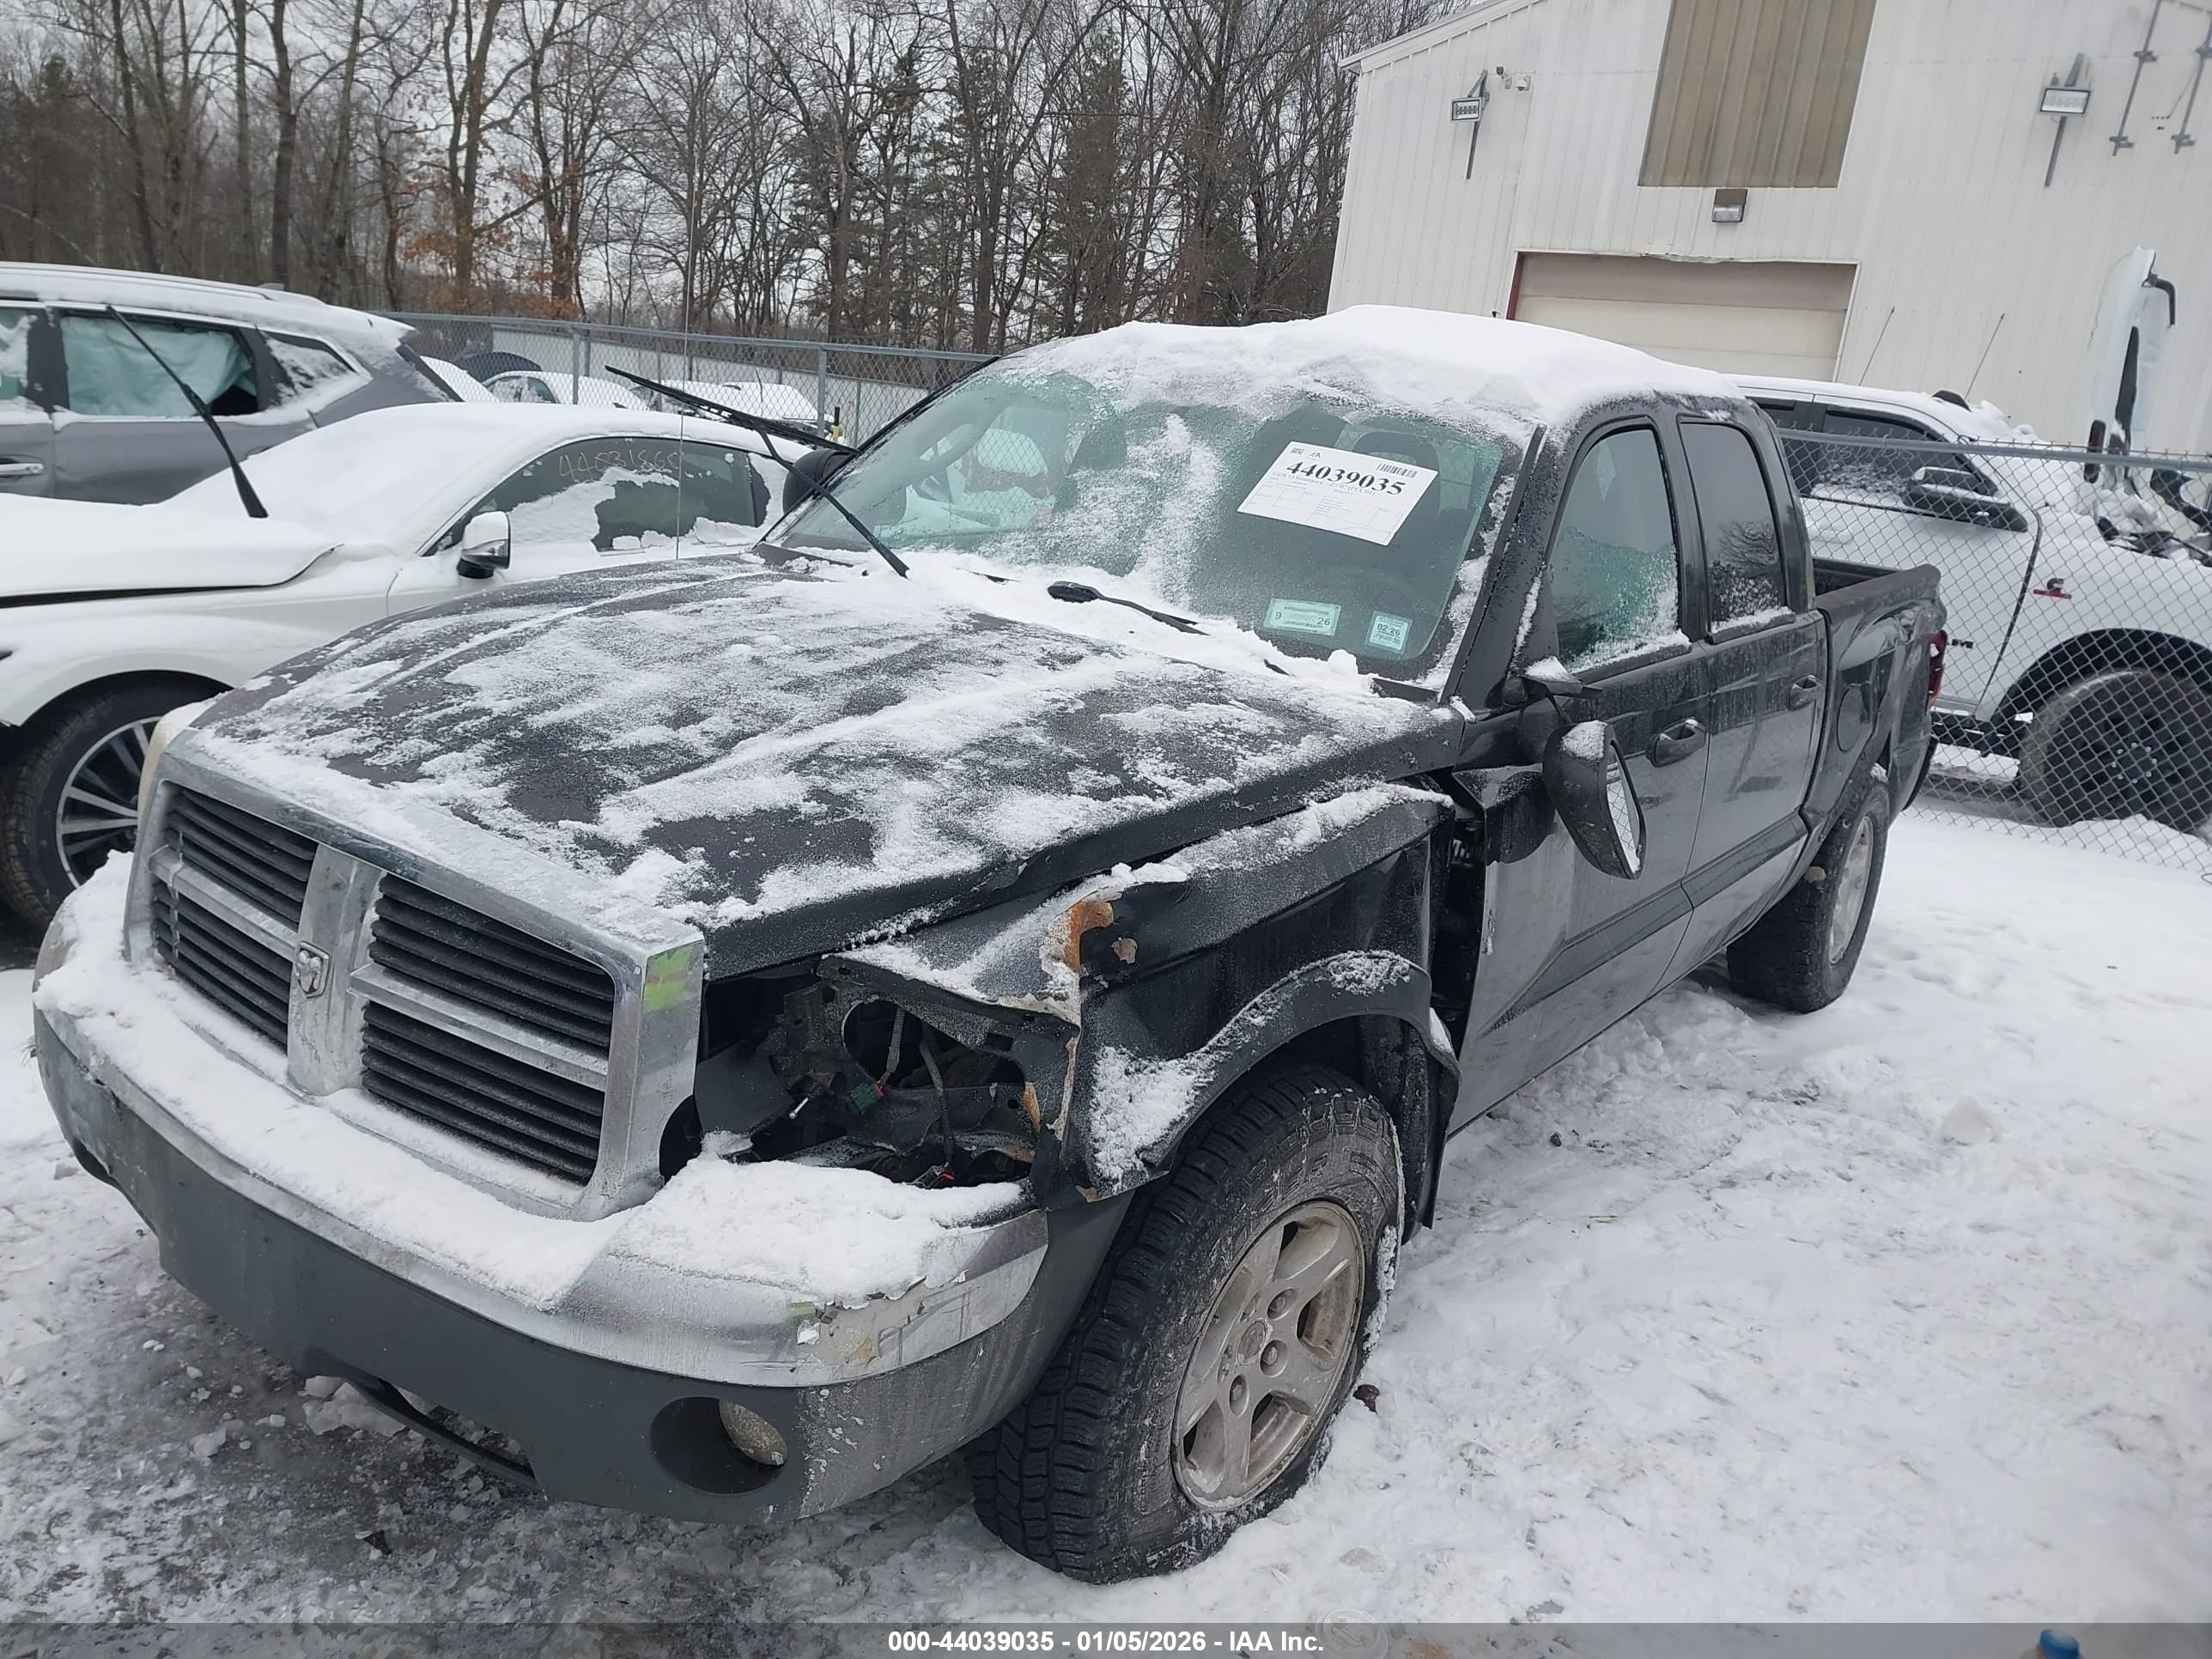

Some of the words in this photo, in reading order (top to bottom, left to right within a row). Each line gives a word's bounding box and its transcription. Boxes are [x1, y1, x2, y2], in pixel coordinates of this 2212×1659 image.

[1286, 461, 1407, 495] 44039035
[1274, 611, 1282, 620] 9
[1316, 617, 1331, 626] 26
